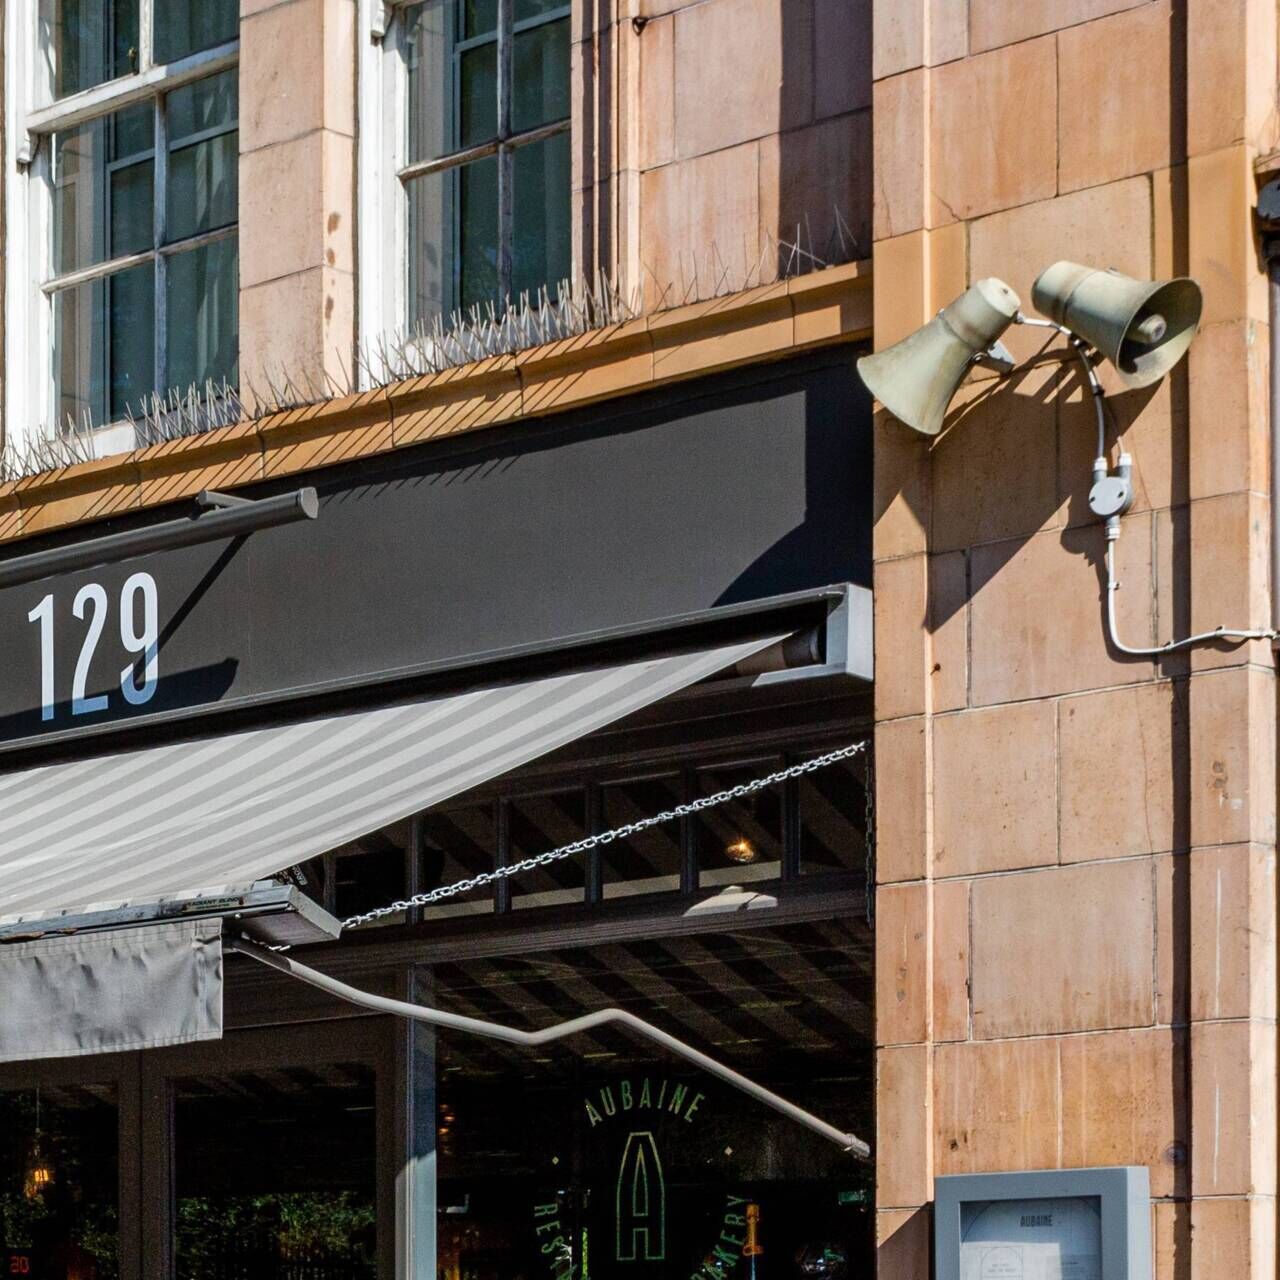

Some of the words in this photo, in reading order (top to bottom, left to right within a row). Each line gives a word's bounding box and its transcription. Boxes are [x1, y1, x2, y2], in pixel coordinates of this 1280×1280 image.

[28, 572, 159, 721] 129
[586, 1078, 705, 1127] AUBAINE
[1020, 1215, 1053, 1227] AUBAINE
